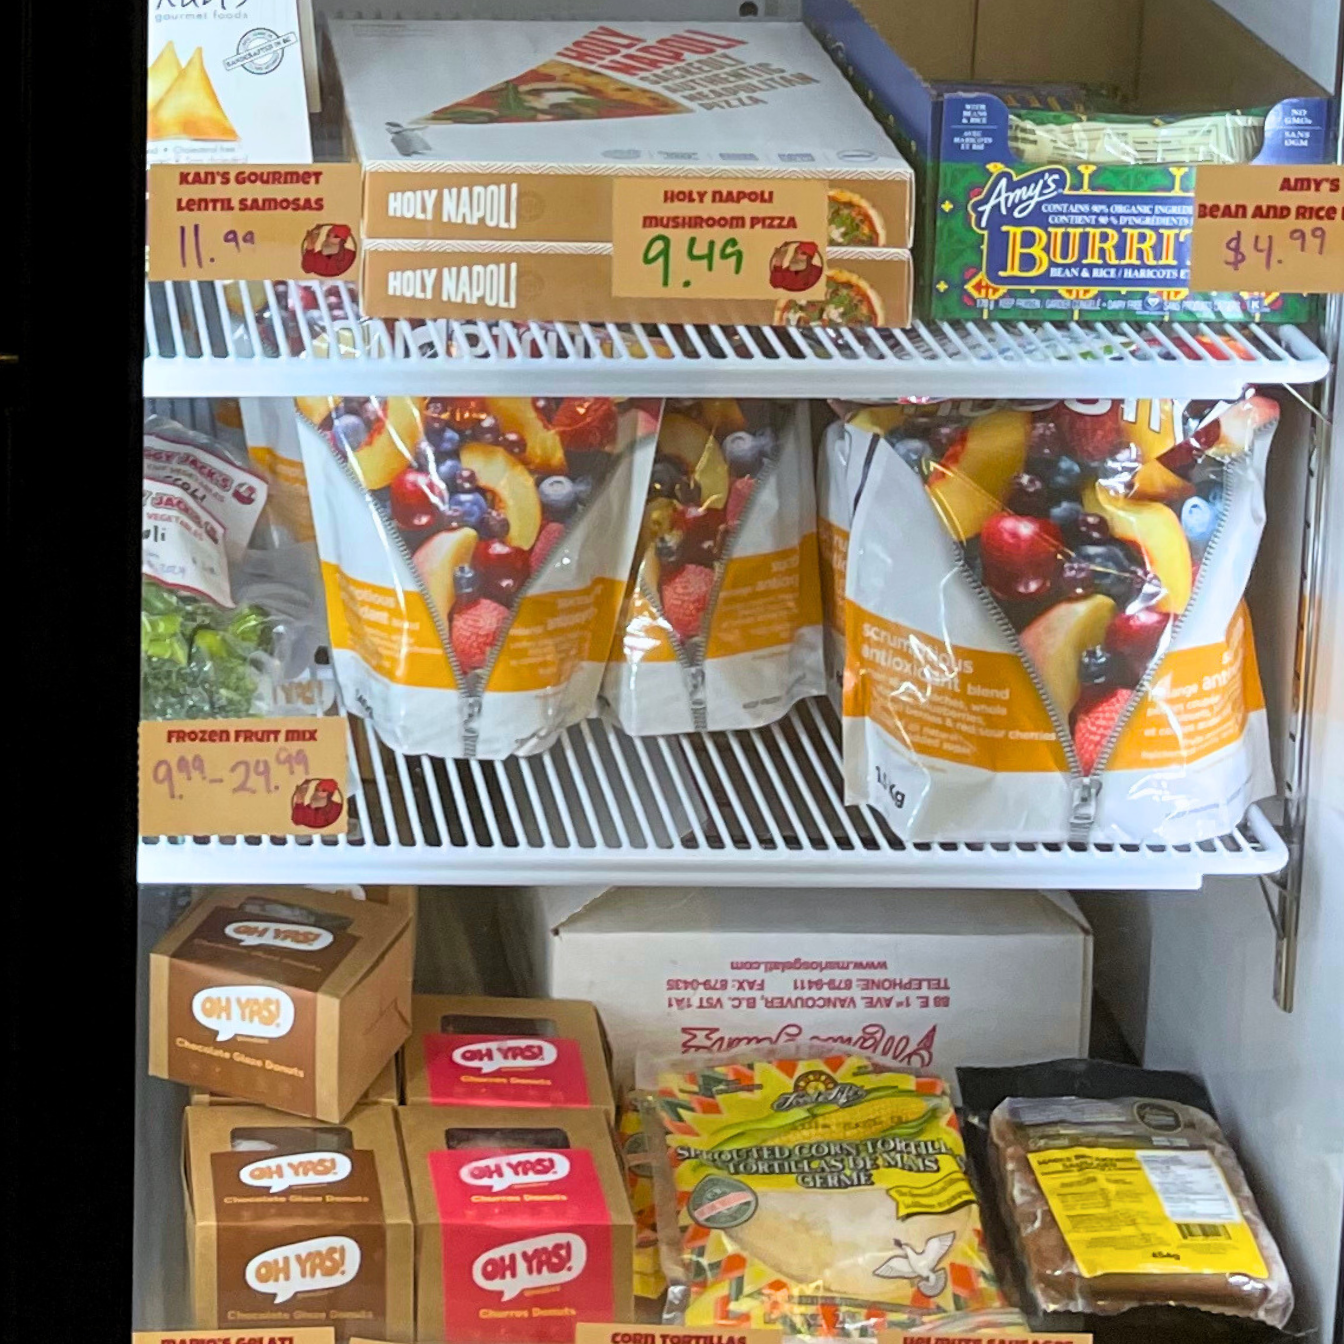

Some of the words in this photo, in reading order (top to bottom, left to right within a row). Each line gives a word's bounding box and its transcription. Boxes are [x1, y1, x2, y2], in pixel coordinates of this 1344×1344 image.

[212, 10, 248, 21] foods
[556, 25, 647, 65] HOLY
[607, 29, 749, 77] NAPOLI
[697, 95, 767, 111] PIZZA
[663, 189, 706, 205] HOLY
[978, 169, 1060, 228] Amy's
[388, 188, 438, 220] HOLY
[442, 182, 518, 229] NAPOLI
[1042, 204, 1091, 214] CONTAINS
[1110, 204, 1154, 214] ORGANIC
[749, 215, 798, 230] PIZZA
[1048, 215, 1096, 225] CONTIENT
[179, 224, 256, 269] 11.99
[1225, 227, 1327, 272] $4.99
[642, 233, 744, 289] 9.49
[1050, 267, 1079, 278] BEAN
[1092, 267, 1116, 278] RICE
[1123, 267, 1178, 279] HARICOTS
[388, 268, 438, 300] HOLY
[442, 262, 518, 309] NAPOLI
[731, 959, 888, 972] www.mariosgelati.com
[793, 978, 853, 991] 879-9411
[201, 995, 233, 1020] OH
[760, 996, 856, 1010] VANCOUVER,
[794, 1142, 857, 1158] CORN
[469, 1163, 504, 1180] OH
[255, 1258, 291, 1283] OH
[480, 1257, 517, 1282] OH
